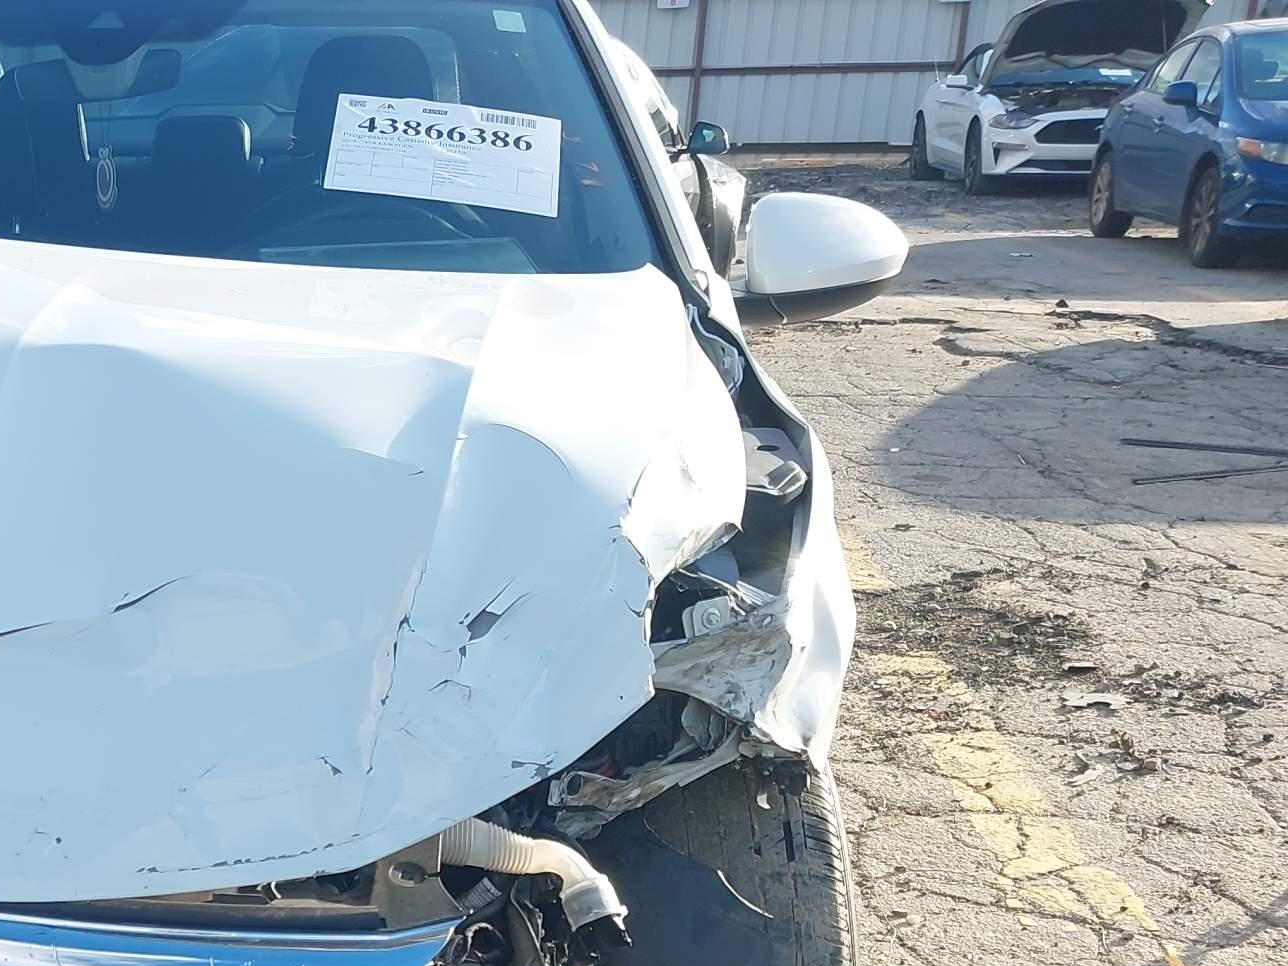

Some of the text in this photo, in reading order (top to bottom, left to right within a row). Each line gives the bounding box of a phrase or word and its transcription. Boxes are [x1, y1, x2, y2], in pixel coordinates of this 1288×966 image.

[342, 131, 395, 142] Progressive
[438, 141, 482, 151] Insurance
[357, 115, 534, 152] 43866386
